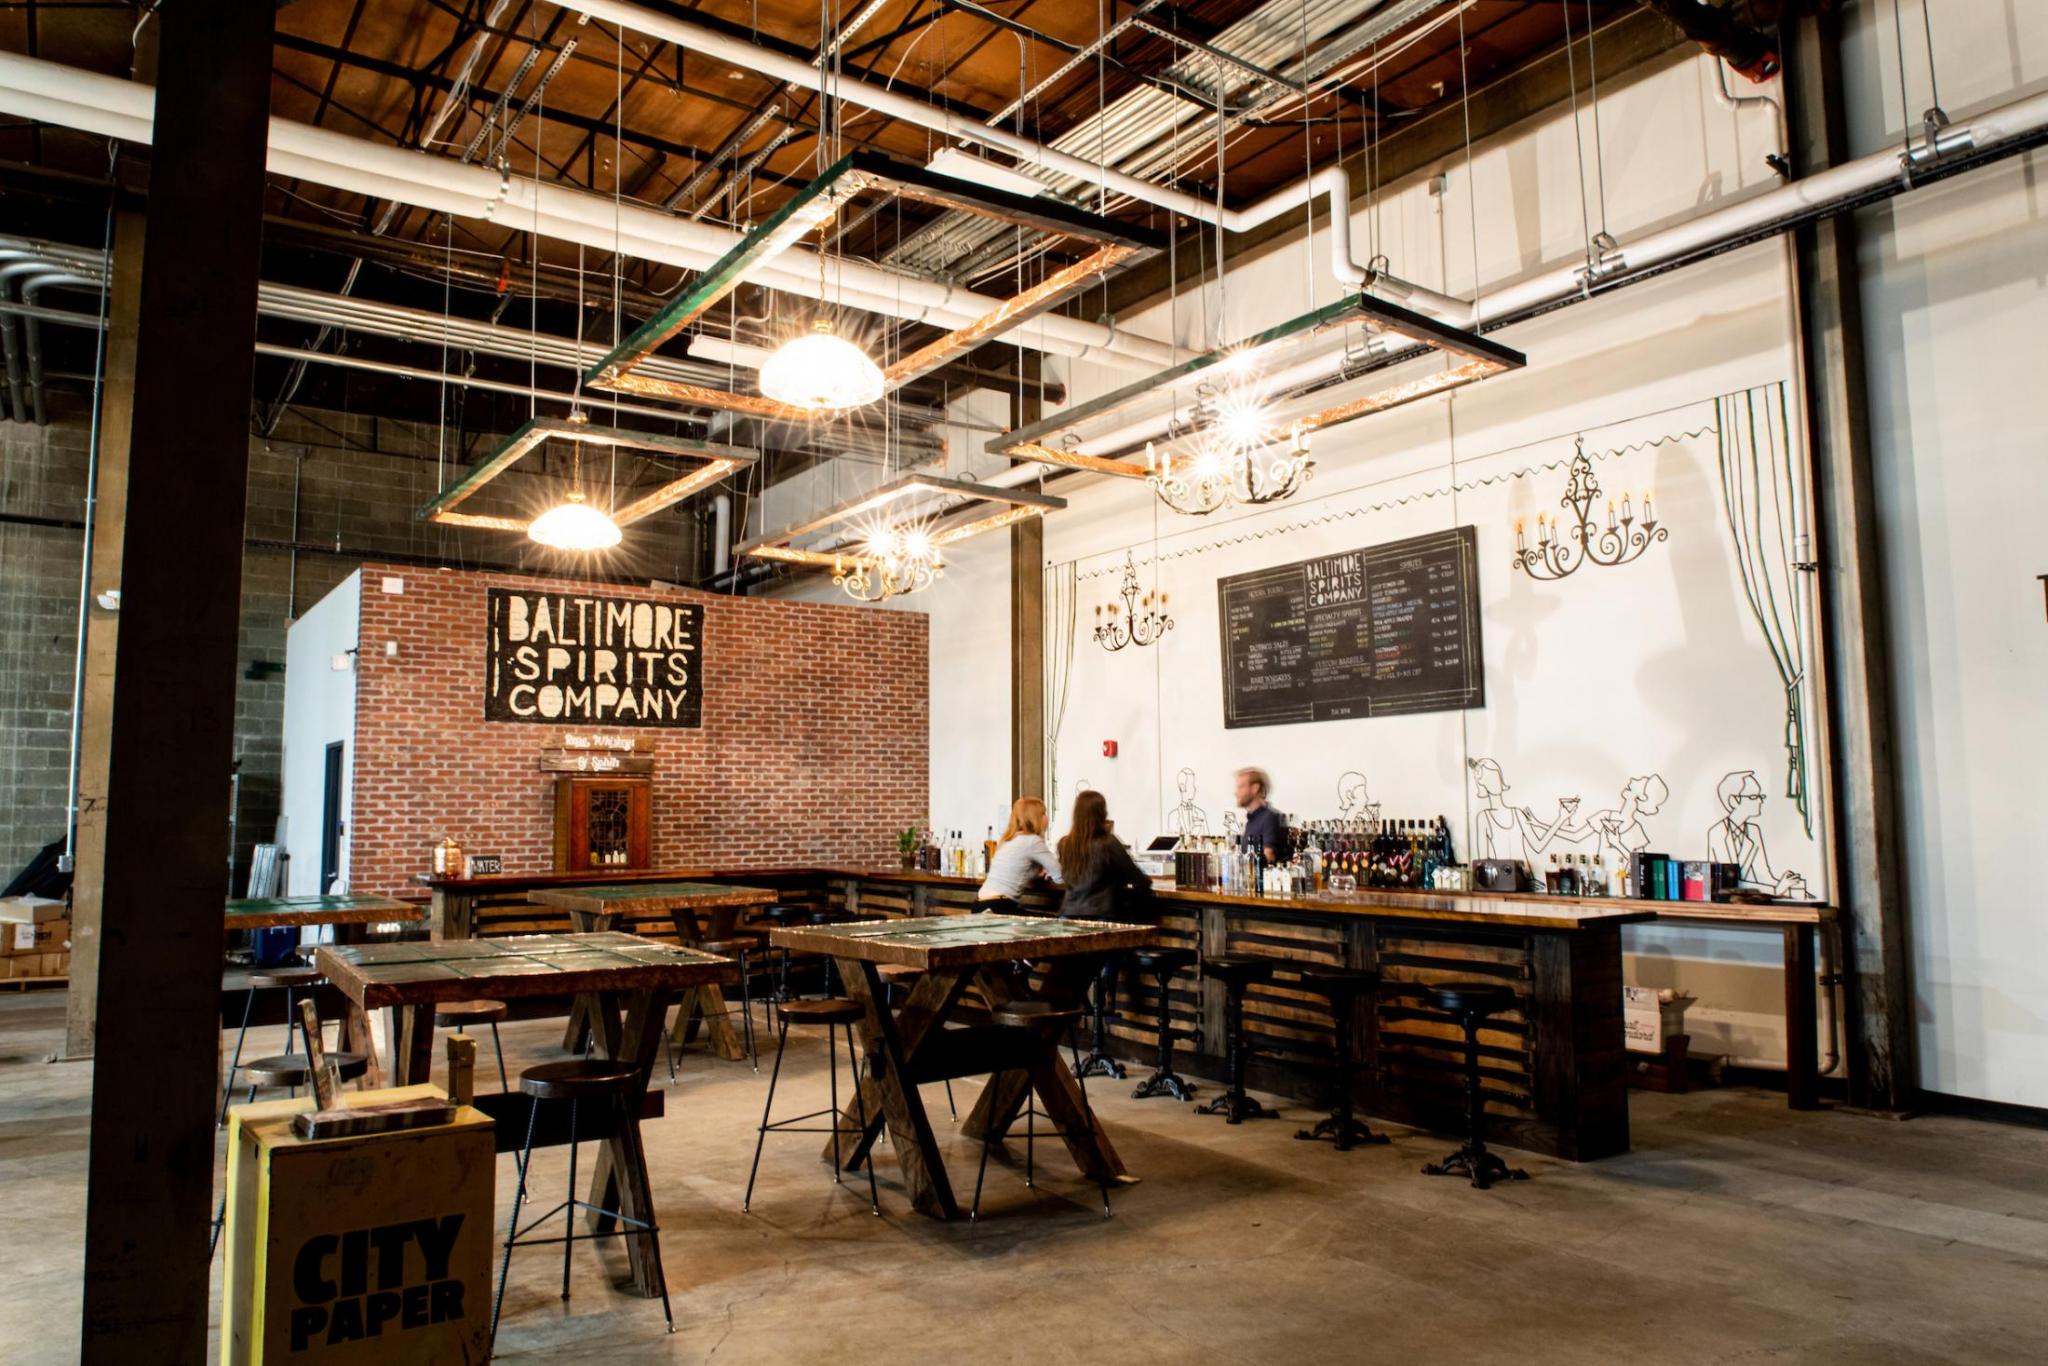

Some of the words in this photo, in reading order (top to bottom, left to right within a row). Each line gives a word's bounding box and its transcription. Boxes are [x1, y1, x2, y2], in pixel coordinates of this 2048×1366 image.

[1307, 553, 1361, 581] BALTIMORE
[1310, 573, 1361, 594] SPIRITS
[1310, 586, 1362, 607] COMPANY
[508, 595, 695, 651] BALTIMORE
[513, 646, 688, 687] SPIRITS
[508, 684, 687, 720] COMPANY
[470, 859, 501, 873] WATER
[293, 1213, 466, 1304] CITY
[290, 1279, 465, 1352] PAPER
